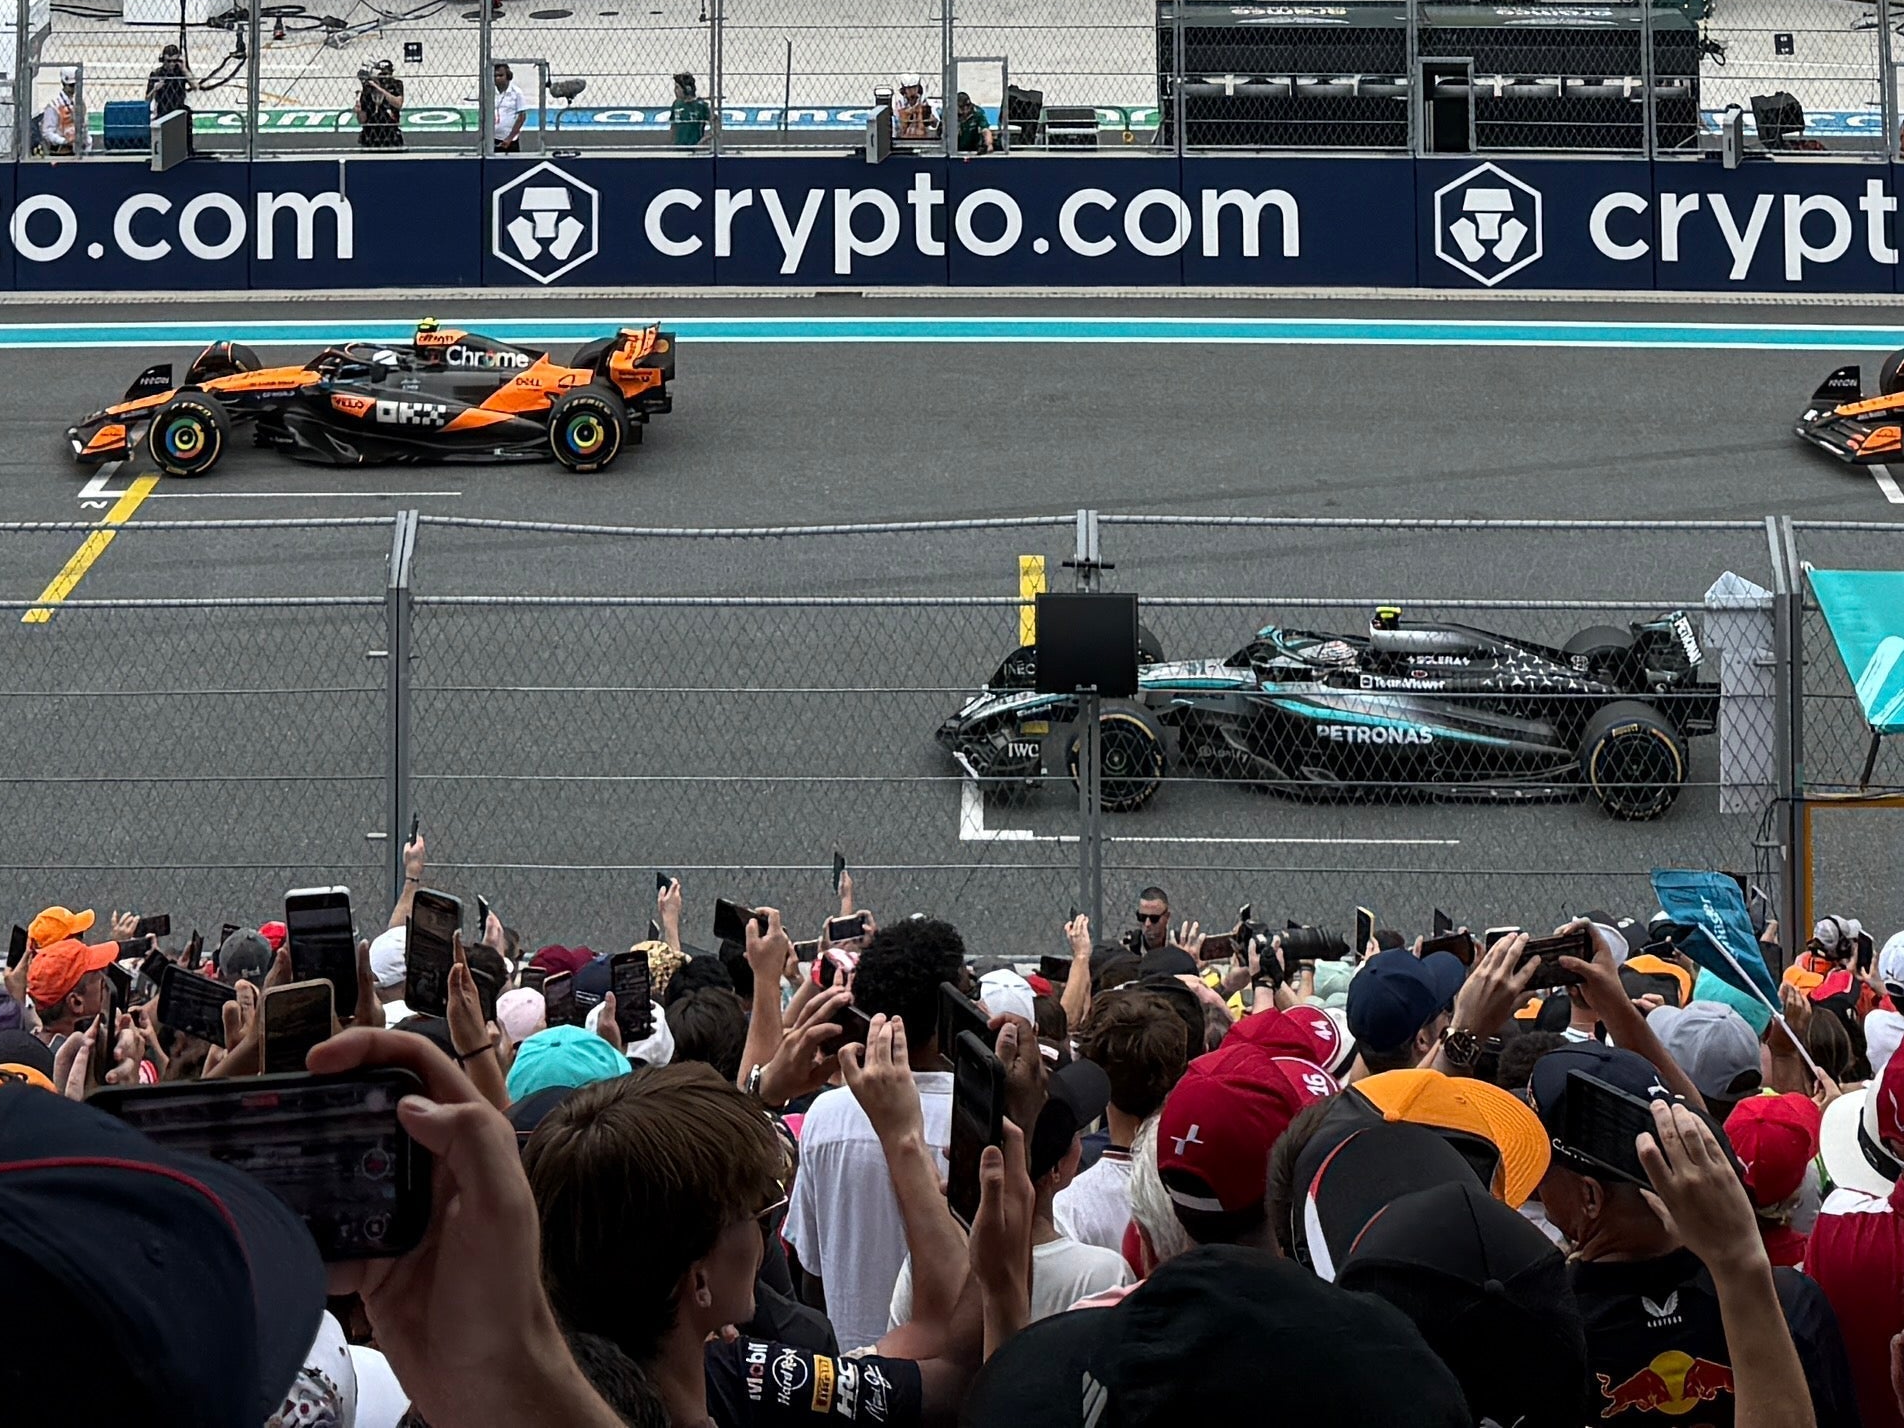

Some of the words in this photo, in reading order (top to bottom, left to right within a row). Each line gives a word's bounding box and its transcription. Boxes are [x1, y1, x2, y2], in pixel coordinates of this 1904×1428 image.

[644, 172, 1300, 275] crypto.com
[446, 345, 531, 369] Chrome
[375, 400, 447, 426] OKX
[1316, 725, 1434, 745] PETRONAS
[1007, 742, 1040, 758] IWC
[1310, 1020, 1333, 1041] 44
[1302, 1072, 1331, 1097] 16
[746, 1341, 769, 1401] Mobil
